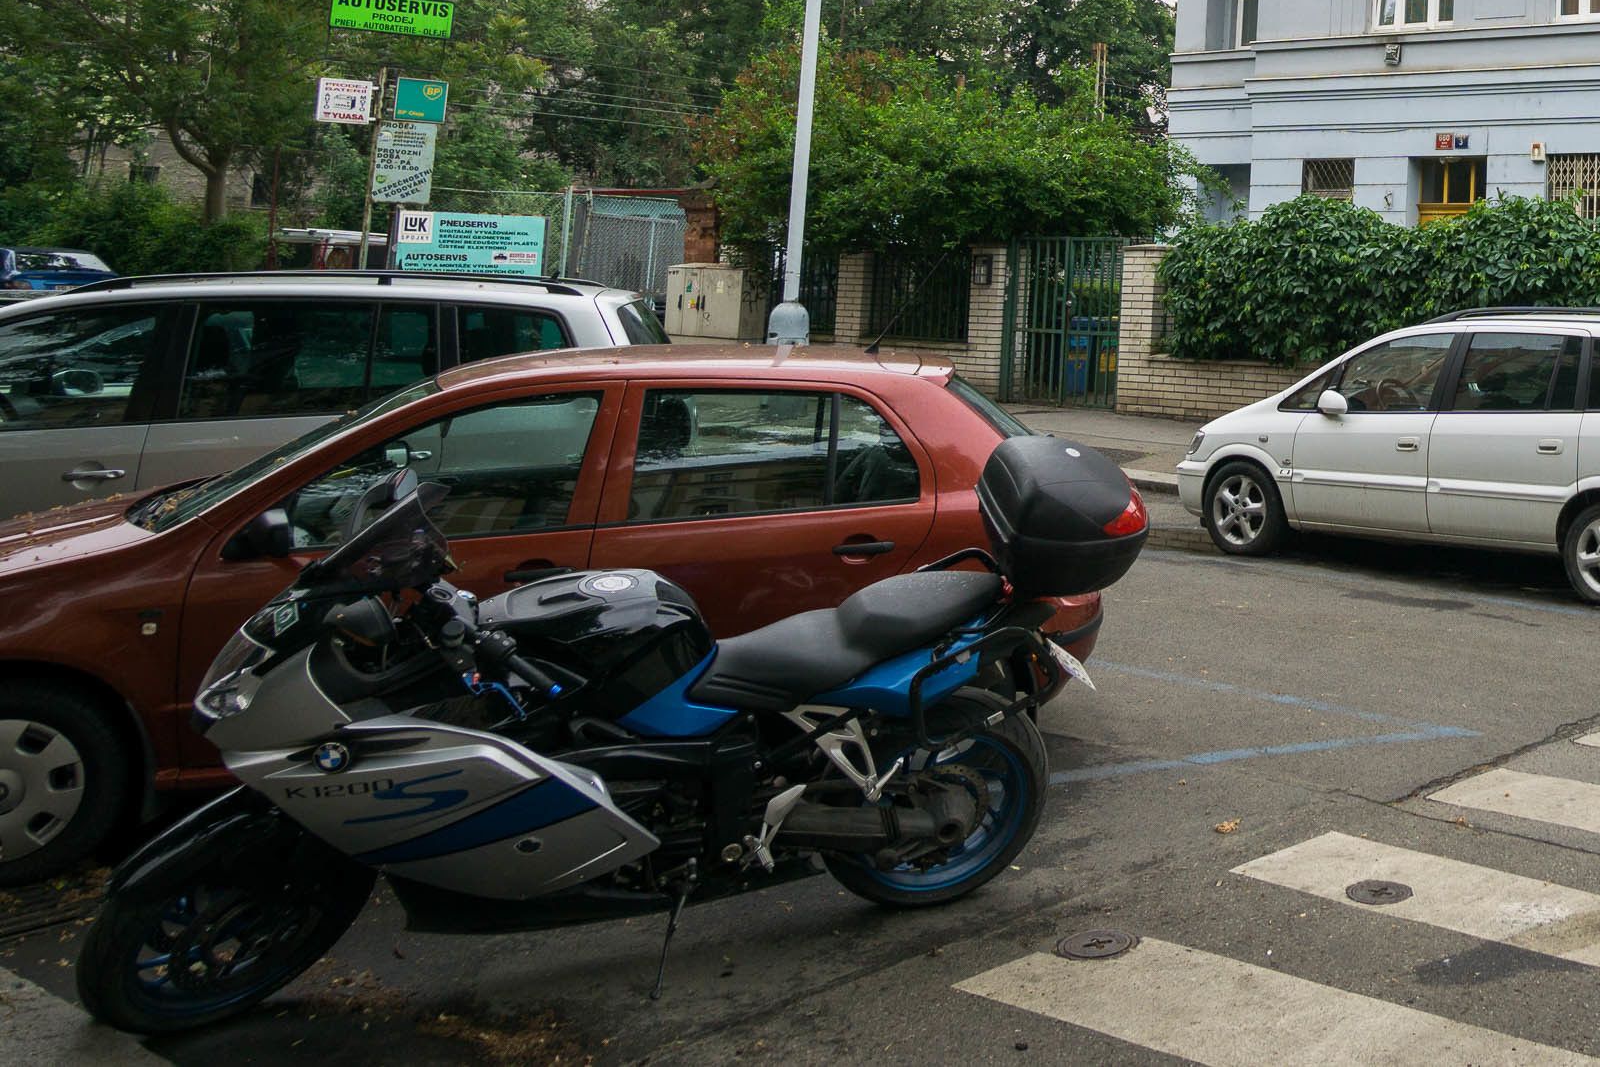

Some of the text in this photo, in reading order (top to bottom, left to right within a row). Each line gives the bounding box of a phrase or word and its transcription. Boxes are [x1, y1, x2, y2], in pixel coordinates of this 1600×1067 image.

[372, 13, 414, 25] PRODEJ
[334, 18, 356, 28] PNEU
[363, 21, 417, 34] AUTOBATERIE
[423, 28, 447, 37] OLEJE
[426, 87, 441, 95] BP
[331, 112, 364, 121] YUASA
[377, 147, 421, 156] PROVOZNÍ
[400, 187, 420, 199] SKEL
[440, 219, 498, 229] PNEUSERVIS
[405, 253, 468, 262] AUTOSERVIS
